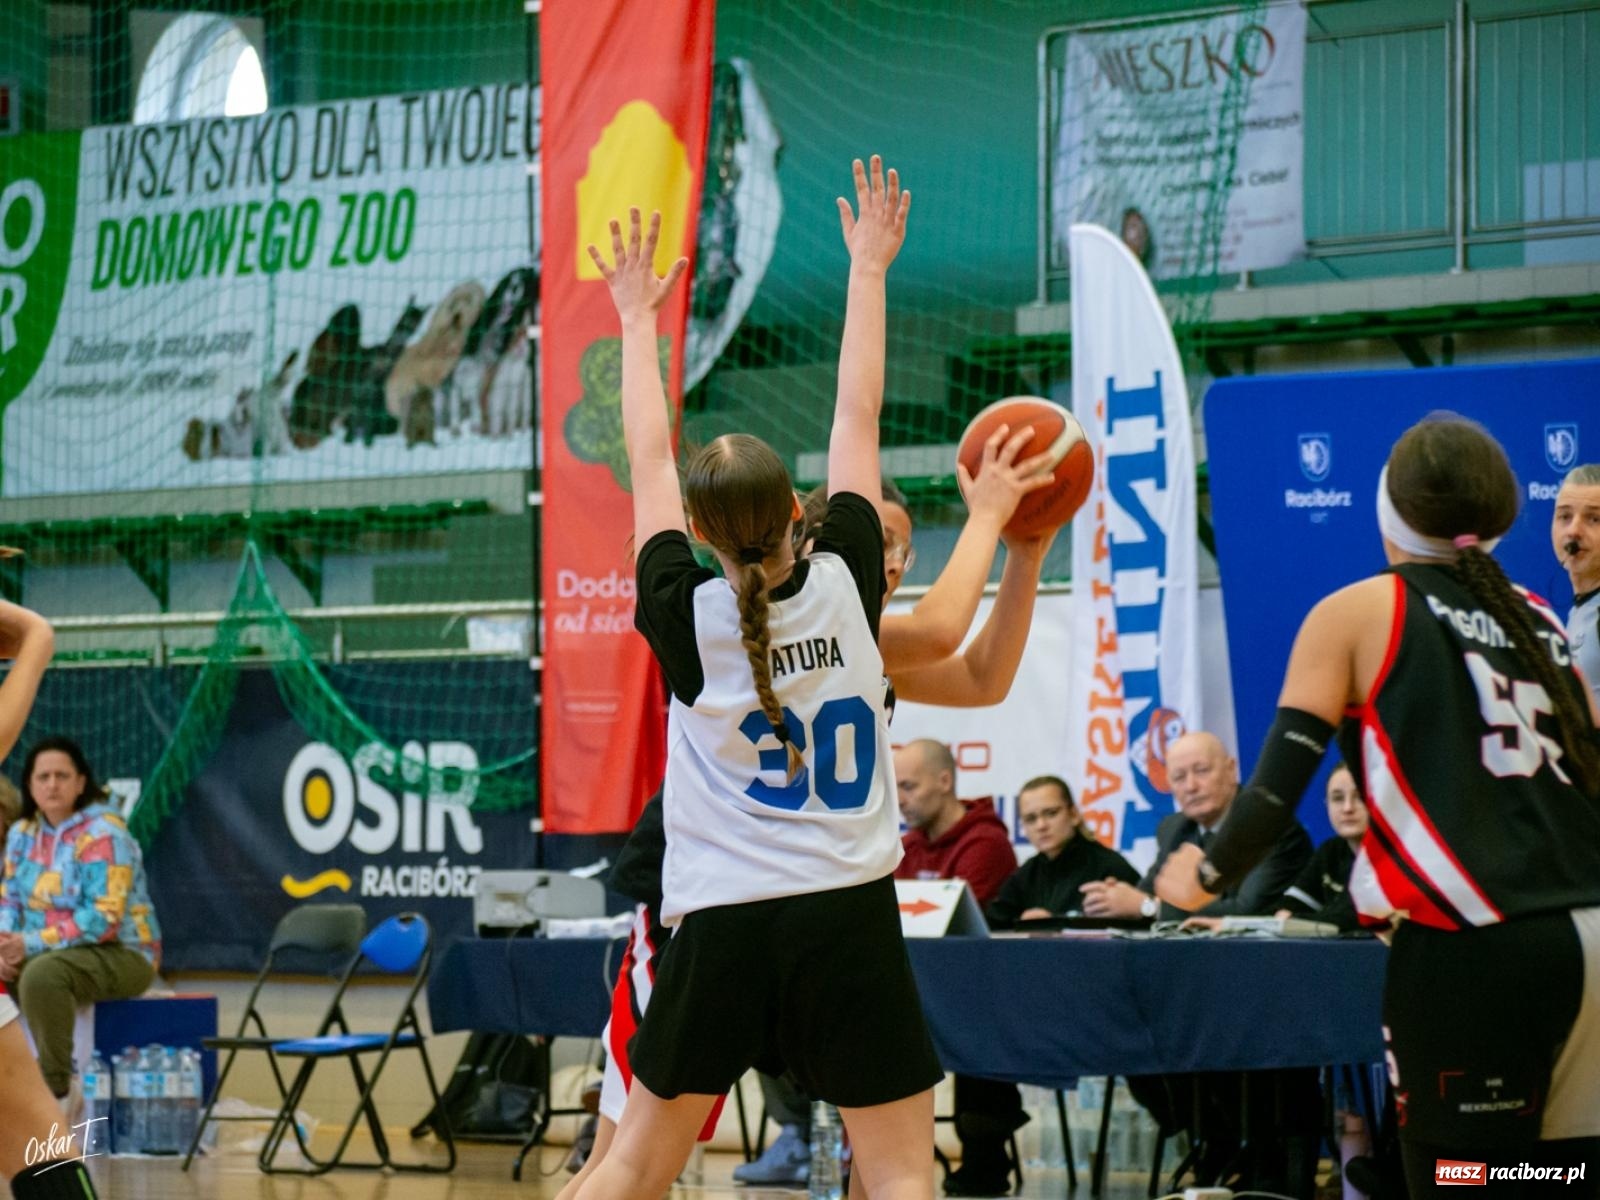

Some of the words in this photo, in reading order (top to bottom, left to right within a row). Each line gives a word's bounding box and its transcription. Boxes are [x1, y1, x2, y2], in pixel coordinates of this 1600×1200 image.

[105, 110, 300, 203] WSZYSTKO
[311, 102, 383, 181] DLA
[400, 82, 541, 170] TWOJEG
[91, 197, 321, 292] DOMOWEGO
[329, 187, 416, 268] ZOO
[770, 637, 845, 679] ATURA
[738, 695, 877, 811] 30
[361, 856, 482, 897] RACIBÓRZ
